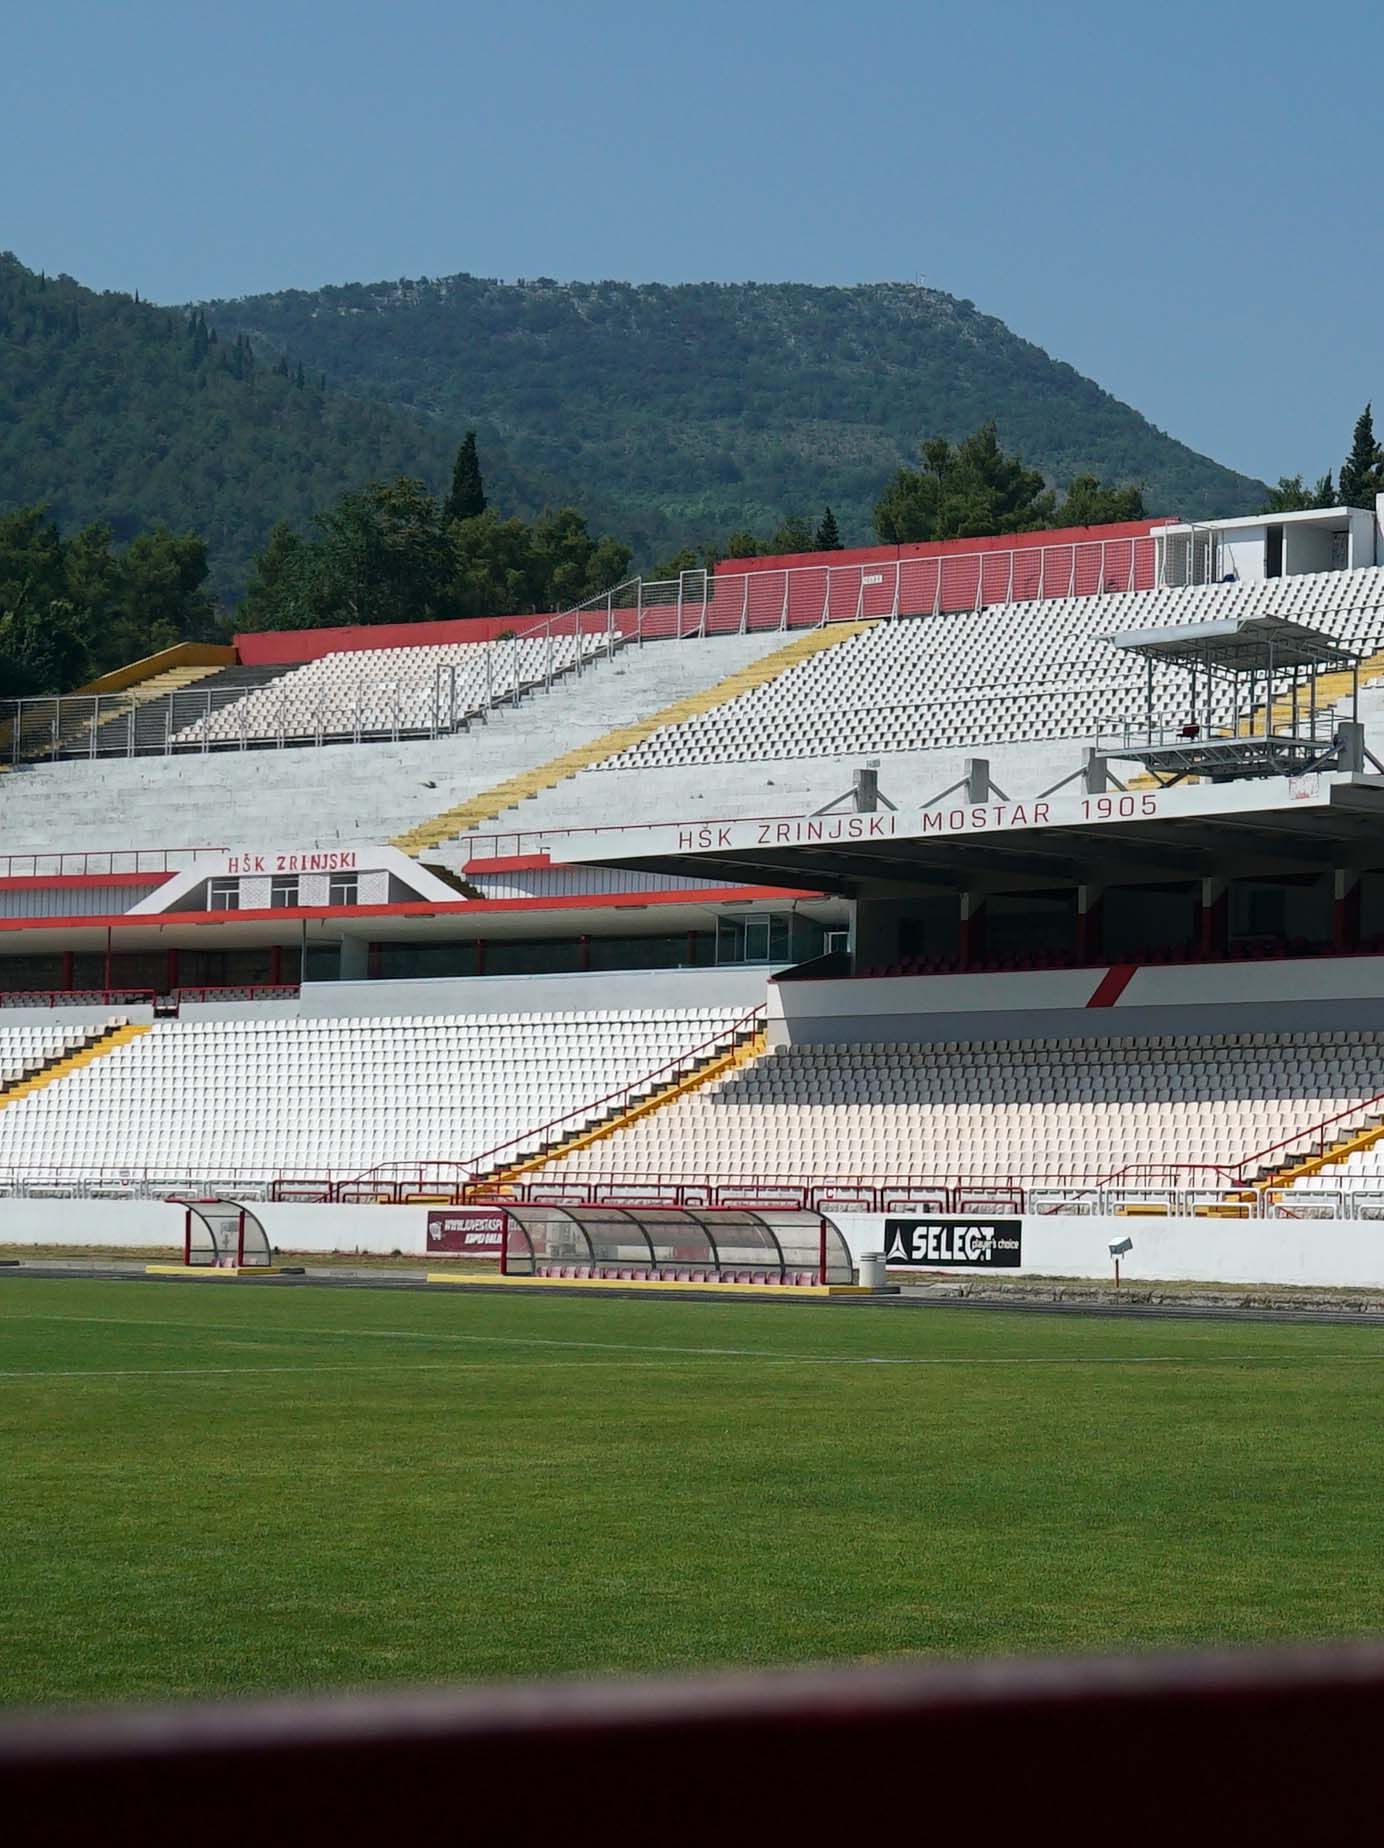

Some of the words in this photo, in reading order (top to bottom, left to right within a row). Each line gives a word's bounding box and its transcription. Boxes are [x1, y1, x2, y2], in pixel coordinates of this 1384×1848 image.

[679, 823, 732, 849] HŠK
[757, 816, 896, 844] ZRINJSKI
[922, 803, 1050, 832] MOSTAR
[1081, 794, 1157, 819] 1905
[228, 853, 265, 873] HŠK
[276, 852, 356, 871] ZRINJSKI
[911, 1226, 995, 1261] SELECT
